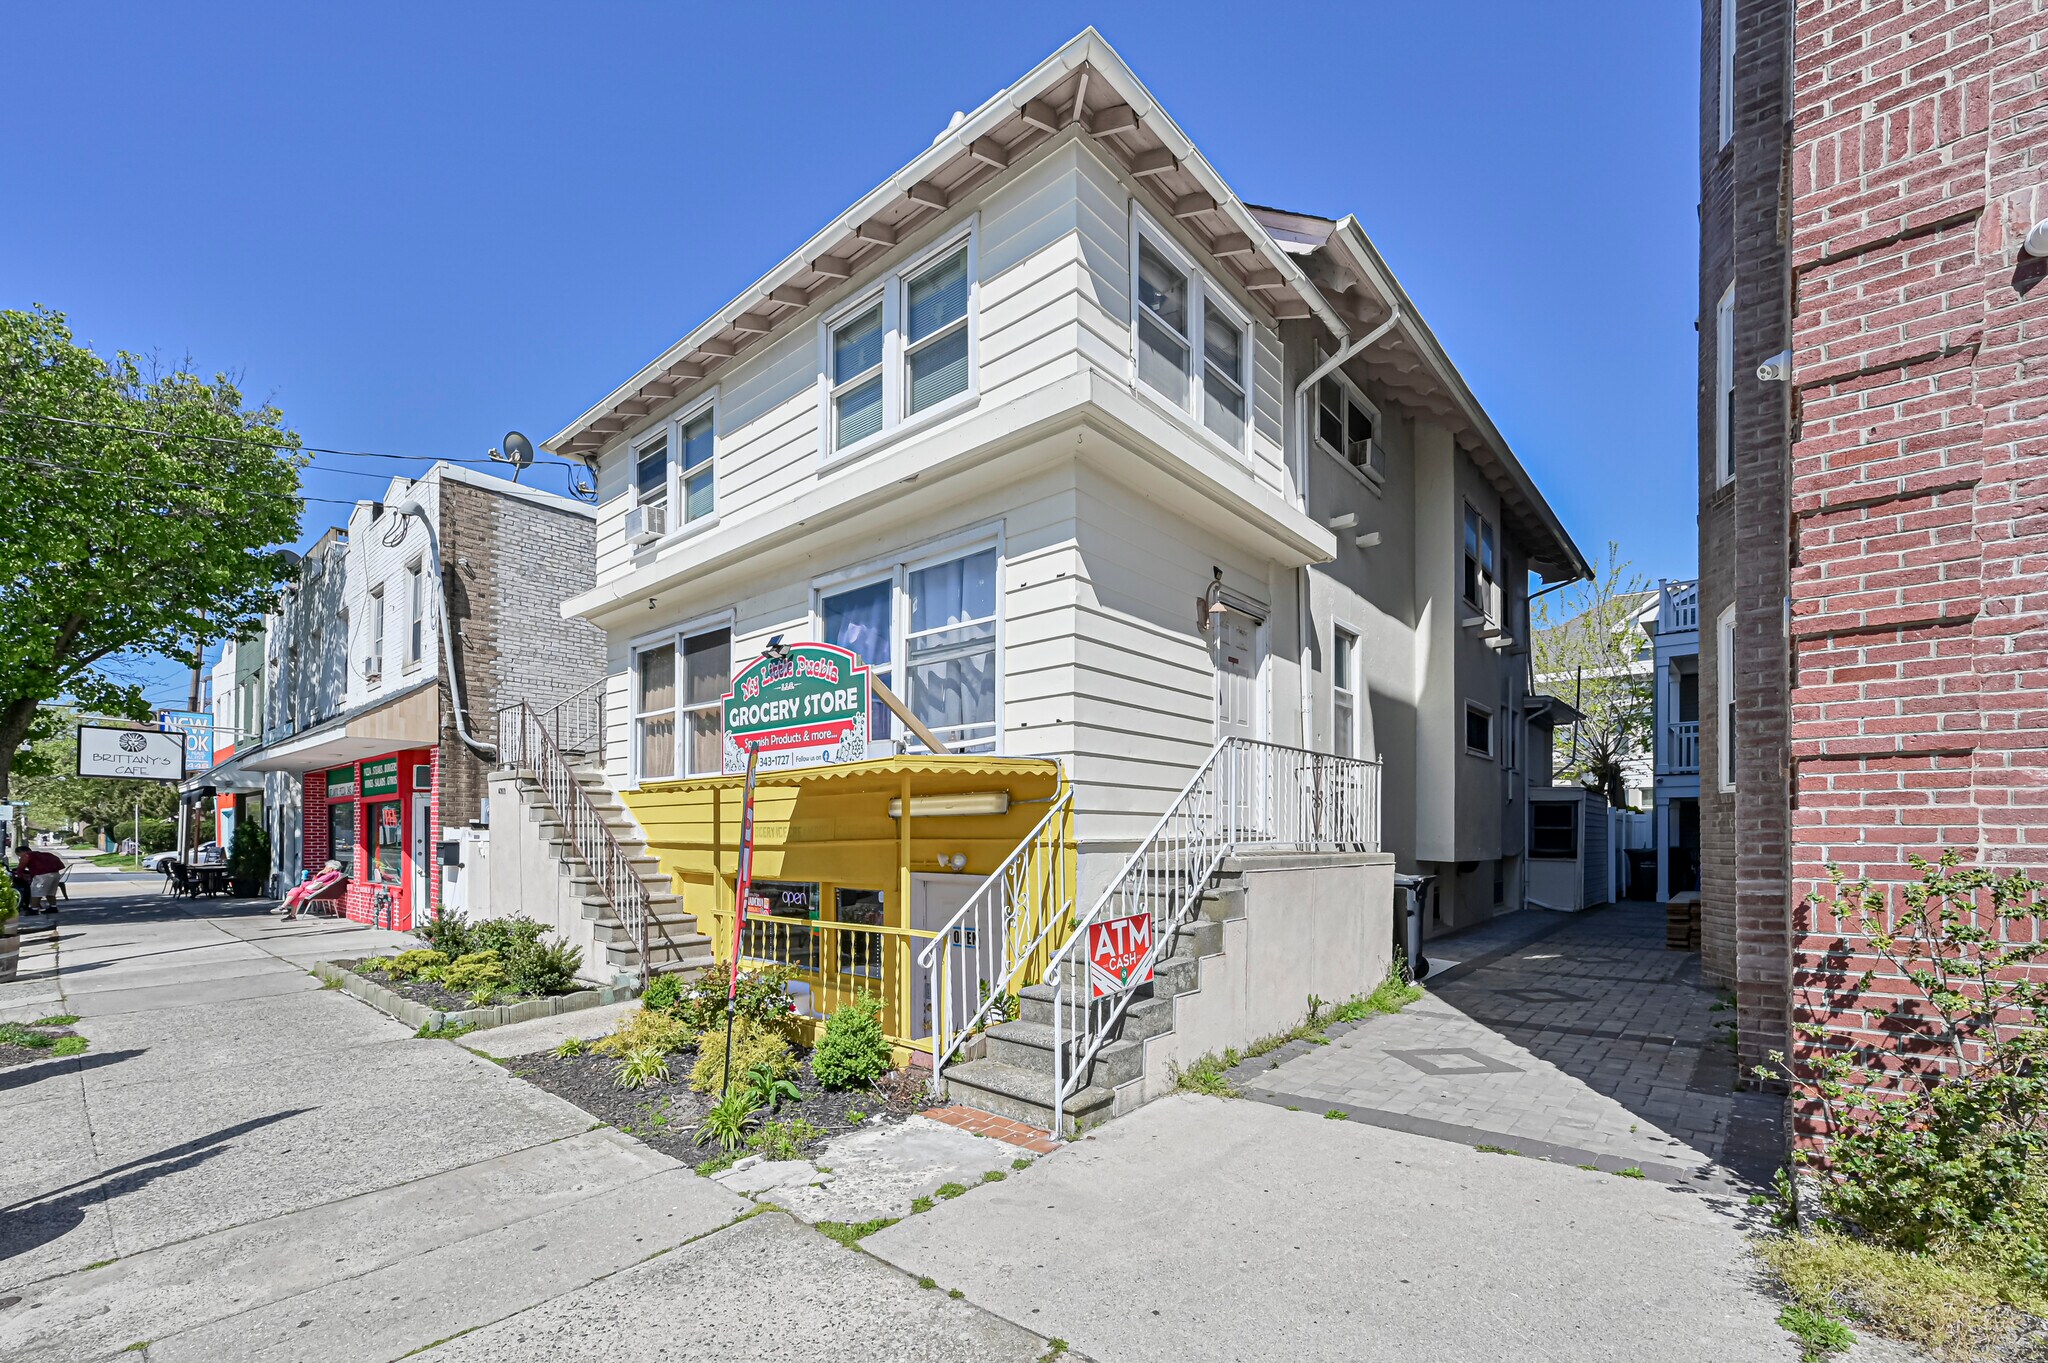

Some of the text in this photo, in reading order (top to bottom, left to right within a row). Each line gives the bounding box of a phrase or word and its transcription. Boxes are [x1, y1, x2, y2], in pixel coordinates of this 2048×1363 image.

[741, 655, 839, 701] My Little Puebla
[729, 687, 858, 728] GROCERY STORE
[186, 735, 209, 752] OK
[771, 731, 802, 745] Products
[803, 730, 810, 741] &
[92, 753, 171, 765] BRITTANY'S
[795, 754, 810, 763] Follow
[115, 766, 149, 776] CAFE
[781, 891, 807, 907] open
[953, 930, 980, 945] OEN
[1094, 919, 1151, 962] ATM
[1109, 952, 1137, 971] CASH
